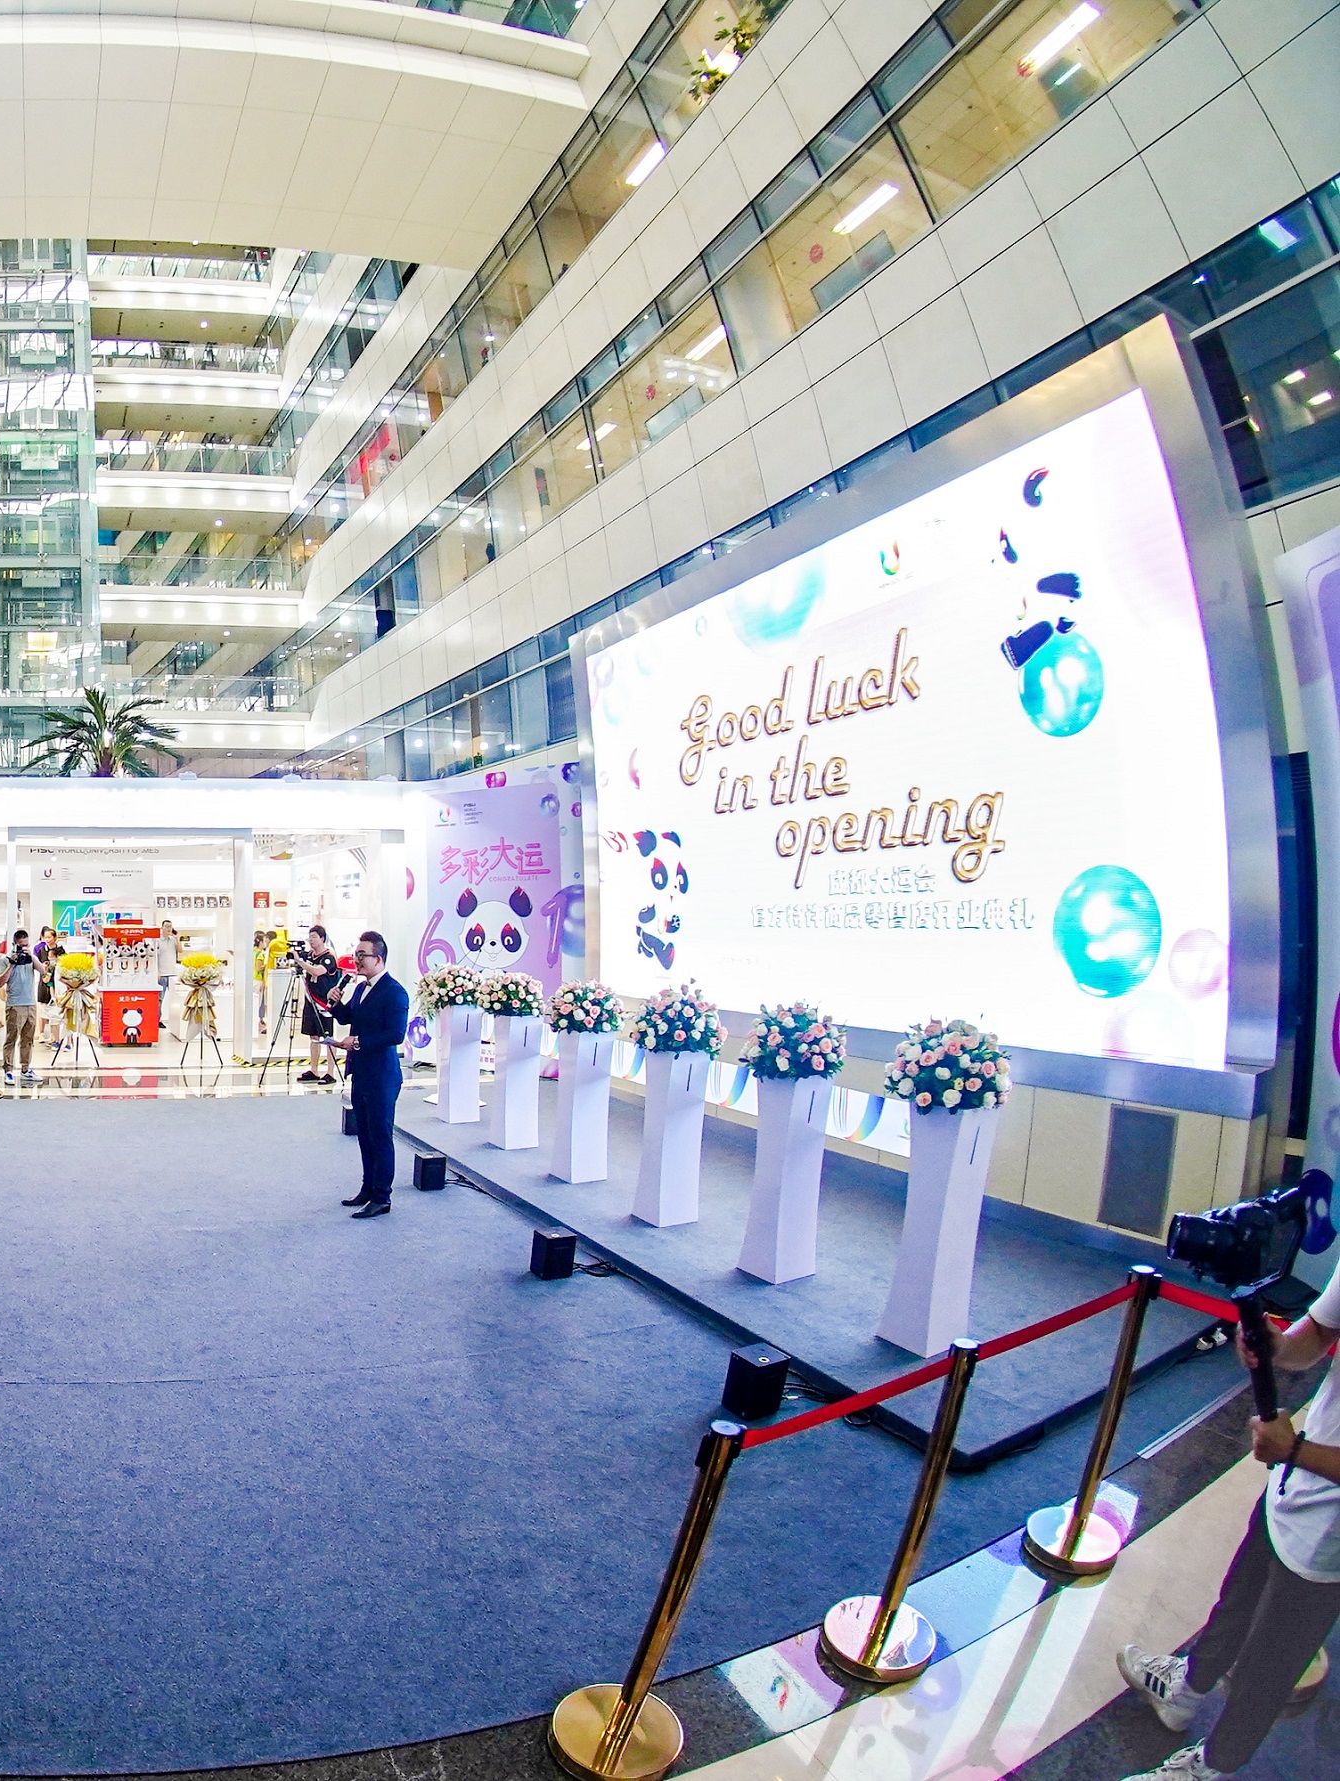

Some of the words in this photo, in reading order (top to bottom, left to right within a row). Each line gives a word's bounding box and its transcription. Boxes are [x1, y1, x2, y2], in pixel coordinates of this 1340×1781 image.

[680, 666, 794, 786] Good
[806, 627, 921, 726] luck
[714, 766, 758, 814] in
[770, 735, 851, 804] the
[439, 837, 551, 885] 多彩大运
[775, 787, 1006, 889] opening
[488, 875, 540, 883] CONGRATULATE
